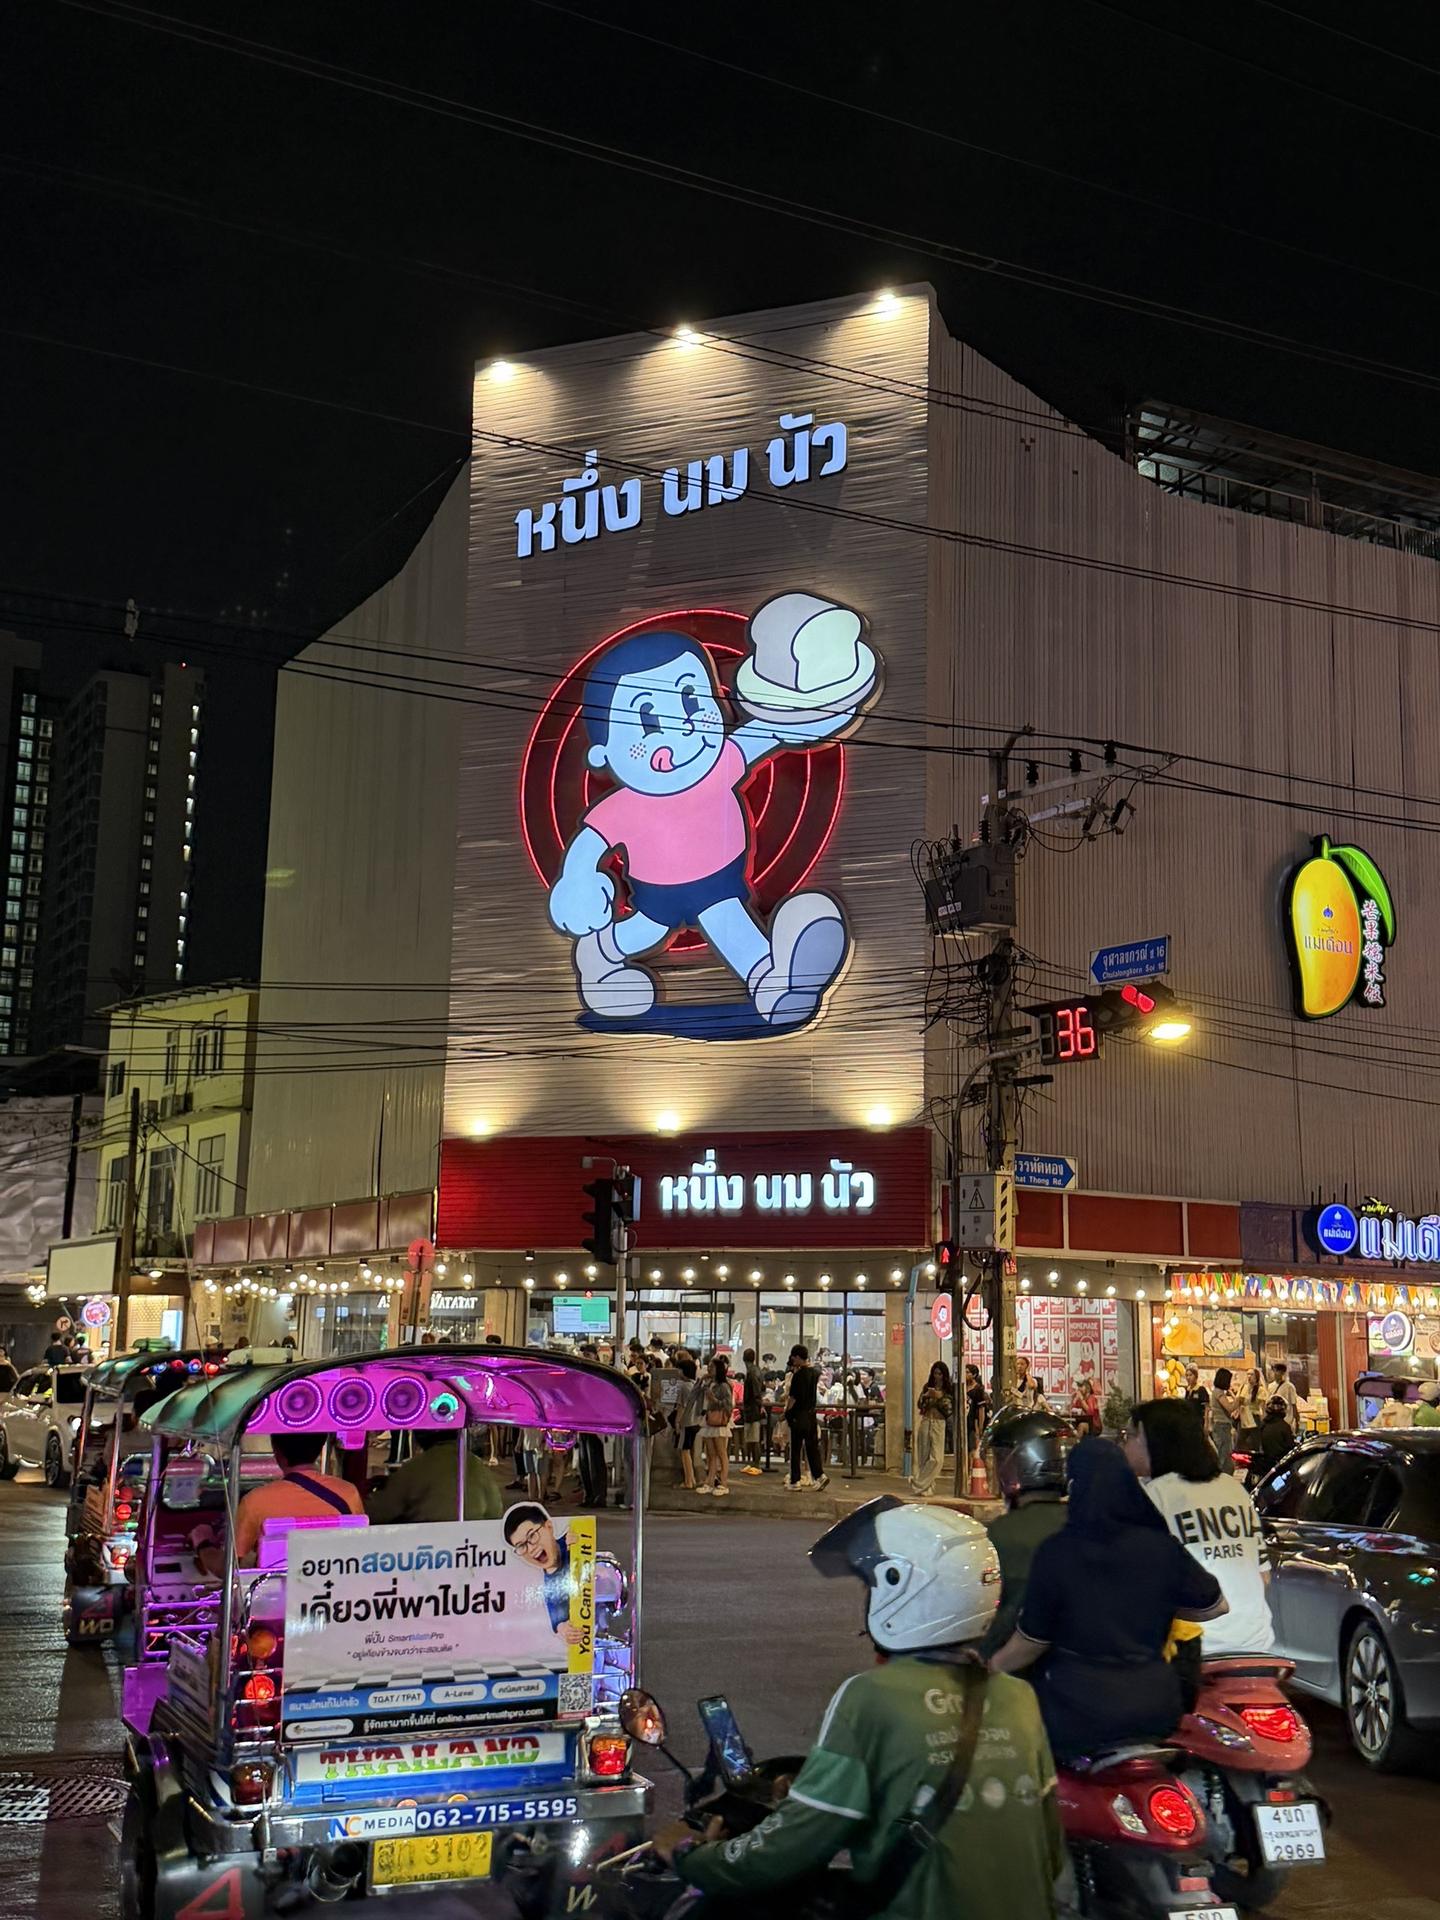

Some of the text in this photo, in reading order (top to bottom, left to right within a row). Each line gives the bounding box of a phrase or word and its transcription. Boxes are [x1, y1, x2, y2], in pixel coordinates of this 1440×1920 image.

[514, 413, 847, 558] หนึ่ง นม นัว
[1103, 944, 1148, 970] จุฬาลงกรณ์
[1157, 946, 1164, 958] 16
[1103, 967, 1142, 979] Chulalongkorn
[1145, 964, 1155, 972] Soi
[1057, 1007, 1094, 1057] 36
[659, 1148, 875, 1210] หนึ่ง นม นัว
[1014, 1157, 1064, 1175] รรทัดทอง
[1029, 1176, 1050, 1186] Thong
[302, 1538, 506, 1577] อยากสอบติดที่ไหน
[1203, 1543, 1244, 1560] PARIS
[580, 1587, 591, 1620] Can
[579, 1625, 590, 1655] You
[320, 1736, 541, 1779] THAILAND
[364, 1815, 414, 1830] MEDIA
[416, 1798, 577, 1830] 062-715-5595
[1274, 1843, 1316, 1860] 2969
